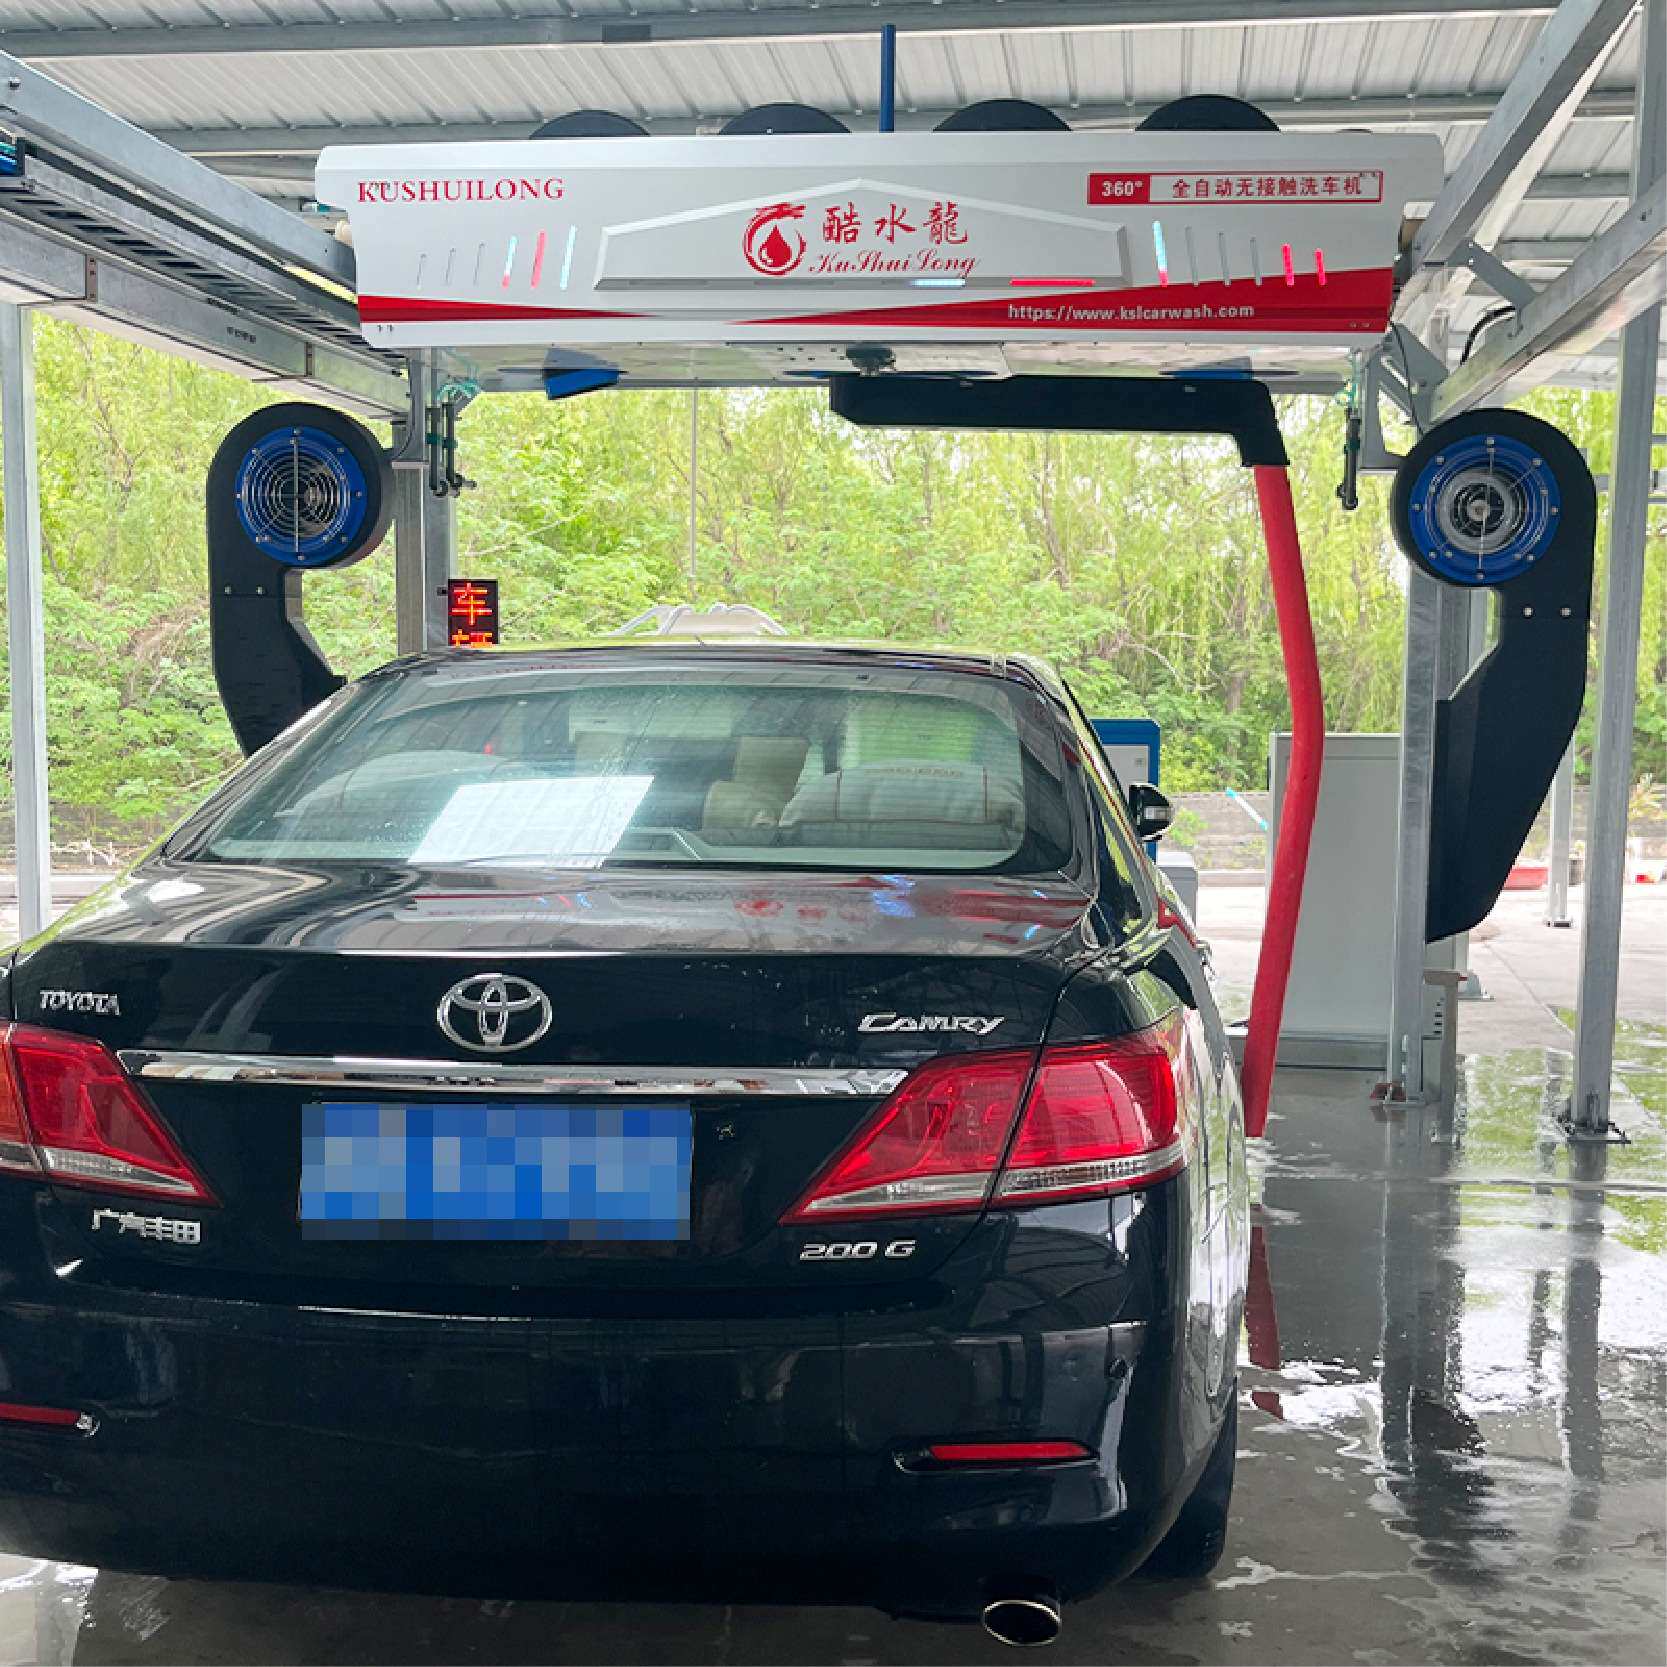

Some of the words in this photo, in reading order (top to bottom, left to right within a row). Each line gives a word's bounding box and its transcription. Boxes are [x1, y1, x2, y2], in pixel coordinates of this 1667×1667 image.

[358, 177, 565, 204] KUSHUILONG
[1171, 175, 1363, 200] 全自动无接触洗车机
[822, 201, 969, 245] 酷水龍
[1007, 303, 1256, 321] https://www.kslcarwash.com
[39, 989, 120, 1017] TOYOTA
[91, 1207, 202, 1245] 广汽丰田
